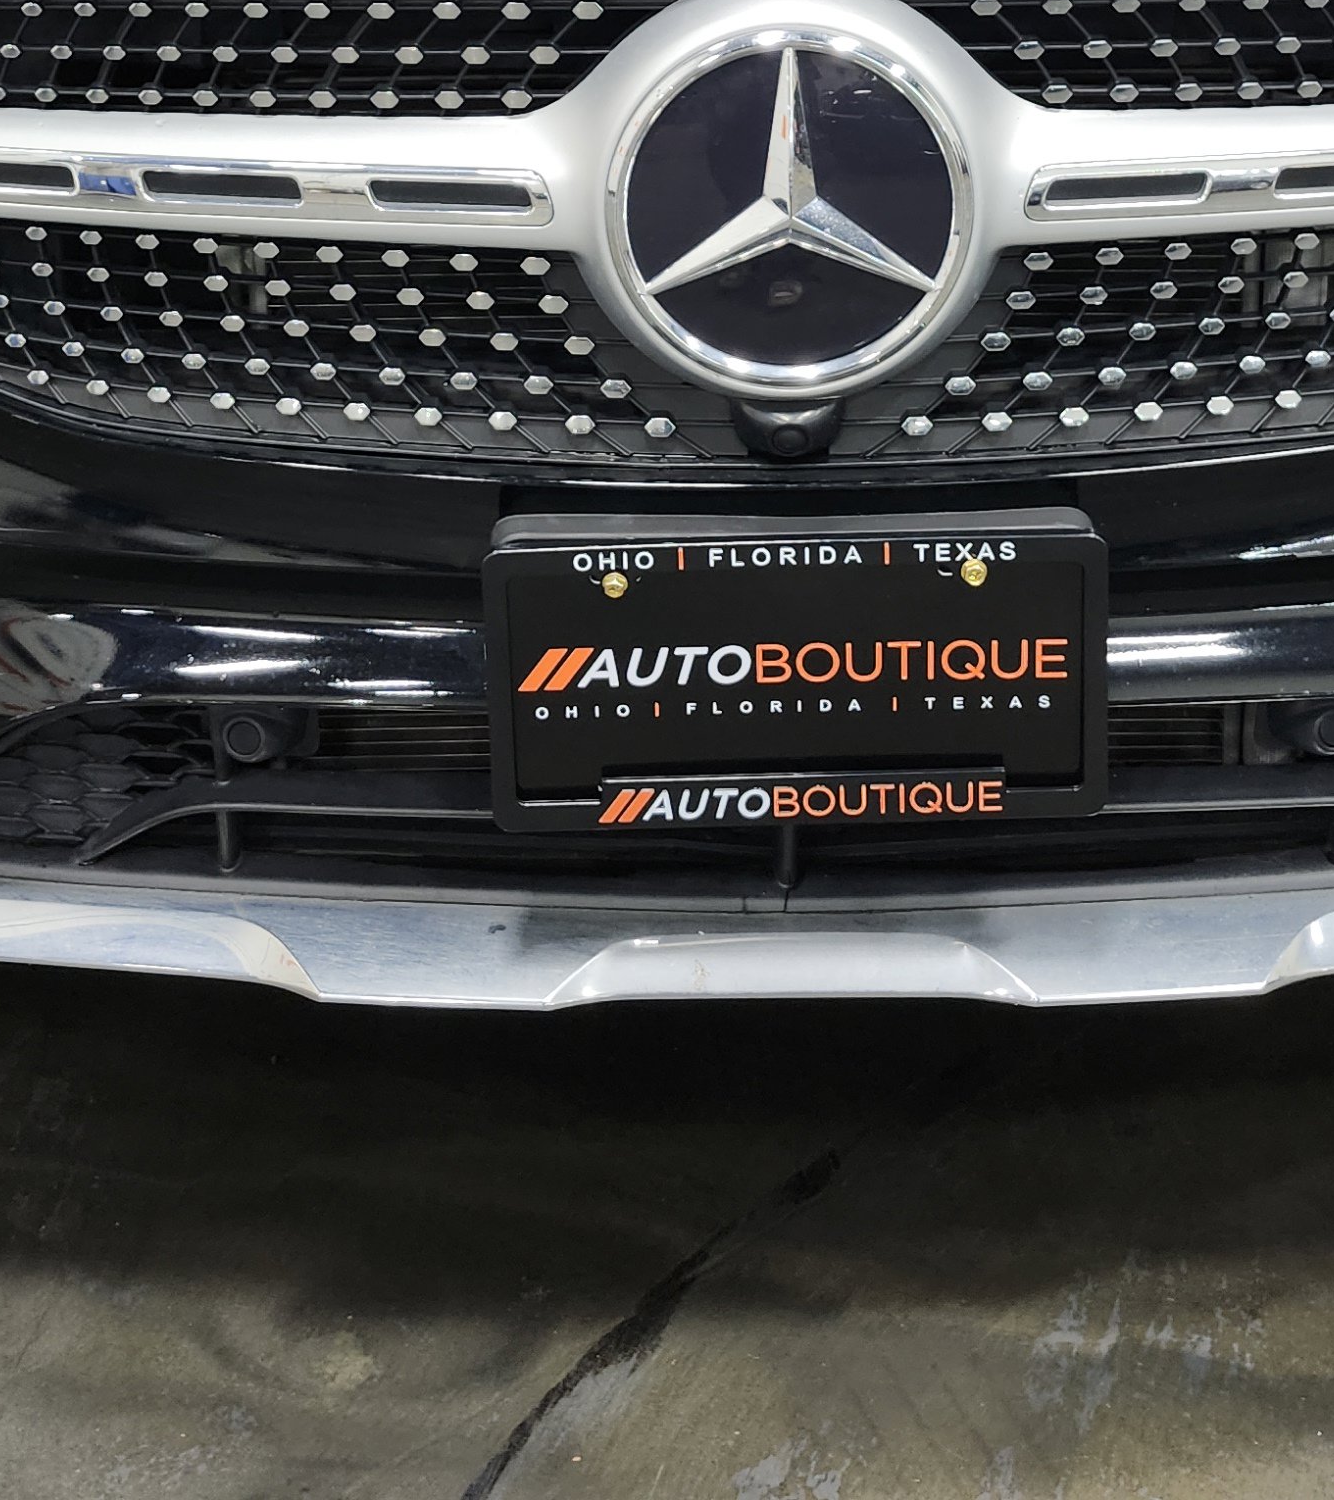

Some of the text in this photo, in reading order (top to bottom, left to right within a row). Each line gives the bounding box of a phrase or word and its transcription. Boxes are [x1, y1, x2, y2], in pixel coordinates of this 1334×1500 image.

[572, 541, 1017, 572] OHIO FLORIDA TEXAS
[577, 638, 1068, 689] AUTOBOUTIQUE
[535, 694, 1051, 720] OHIO FLORIDA TEXAS
[642, 780, 1004, 822] AUTOBOUTIQUE
